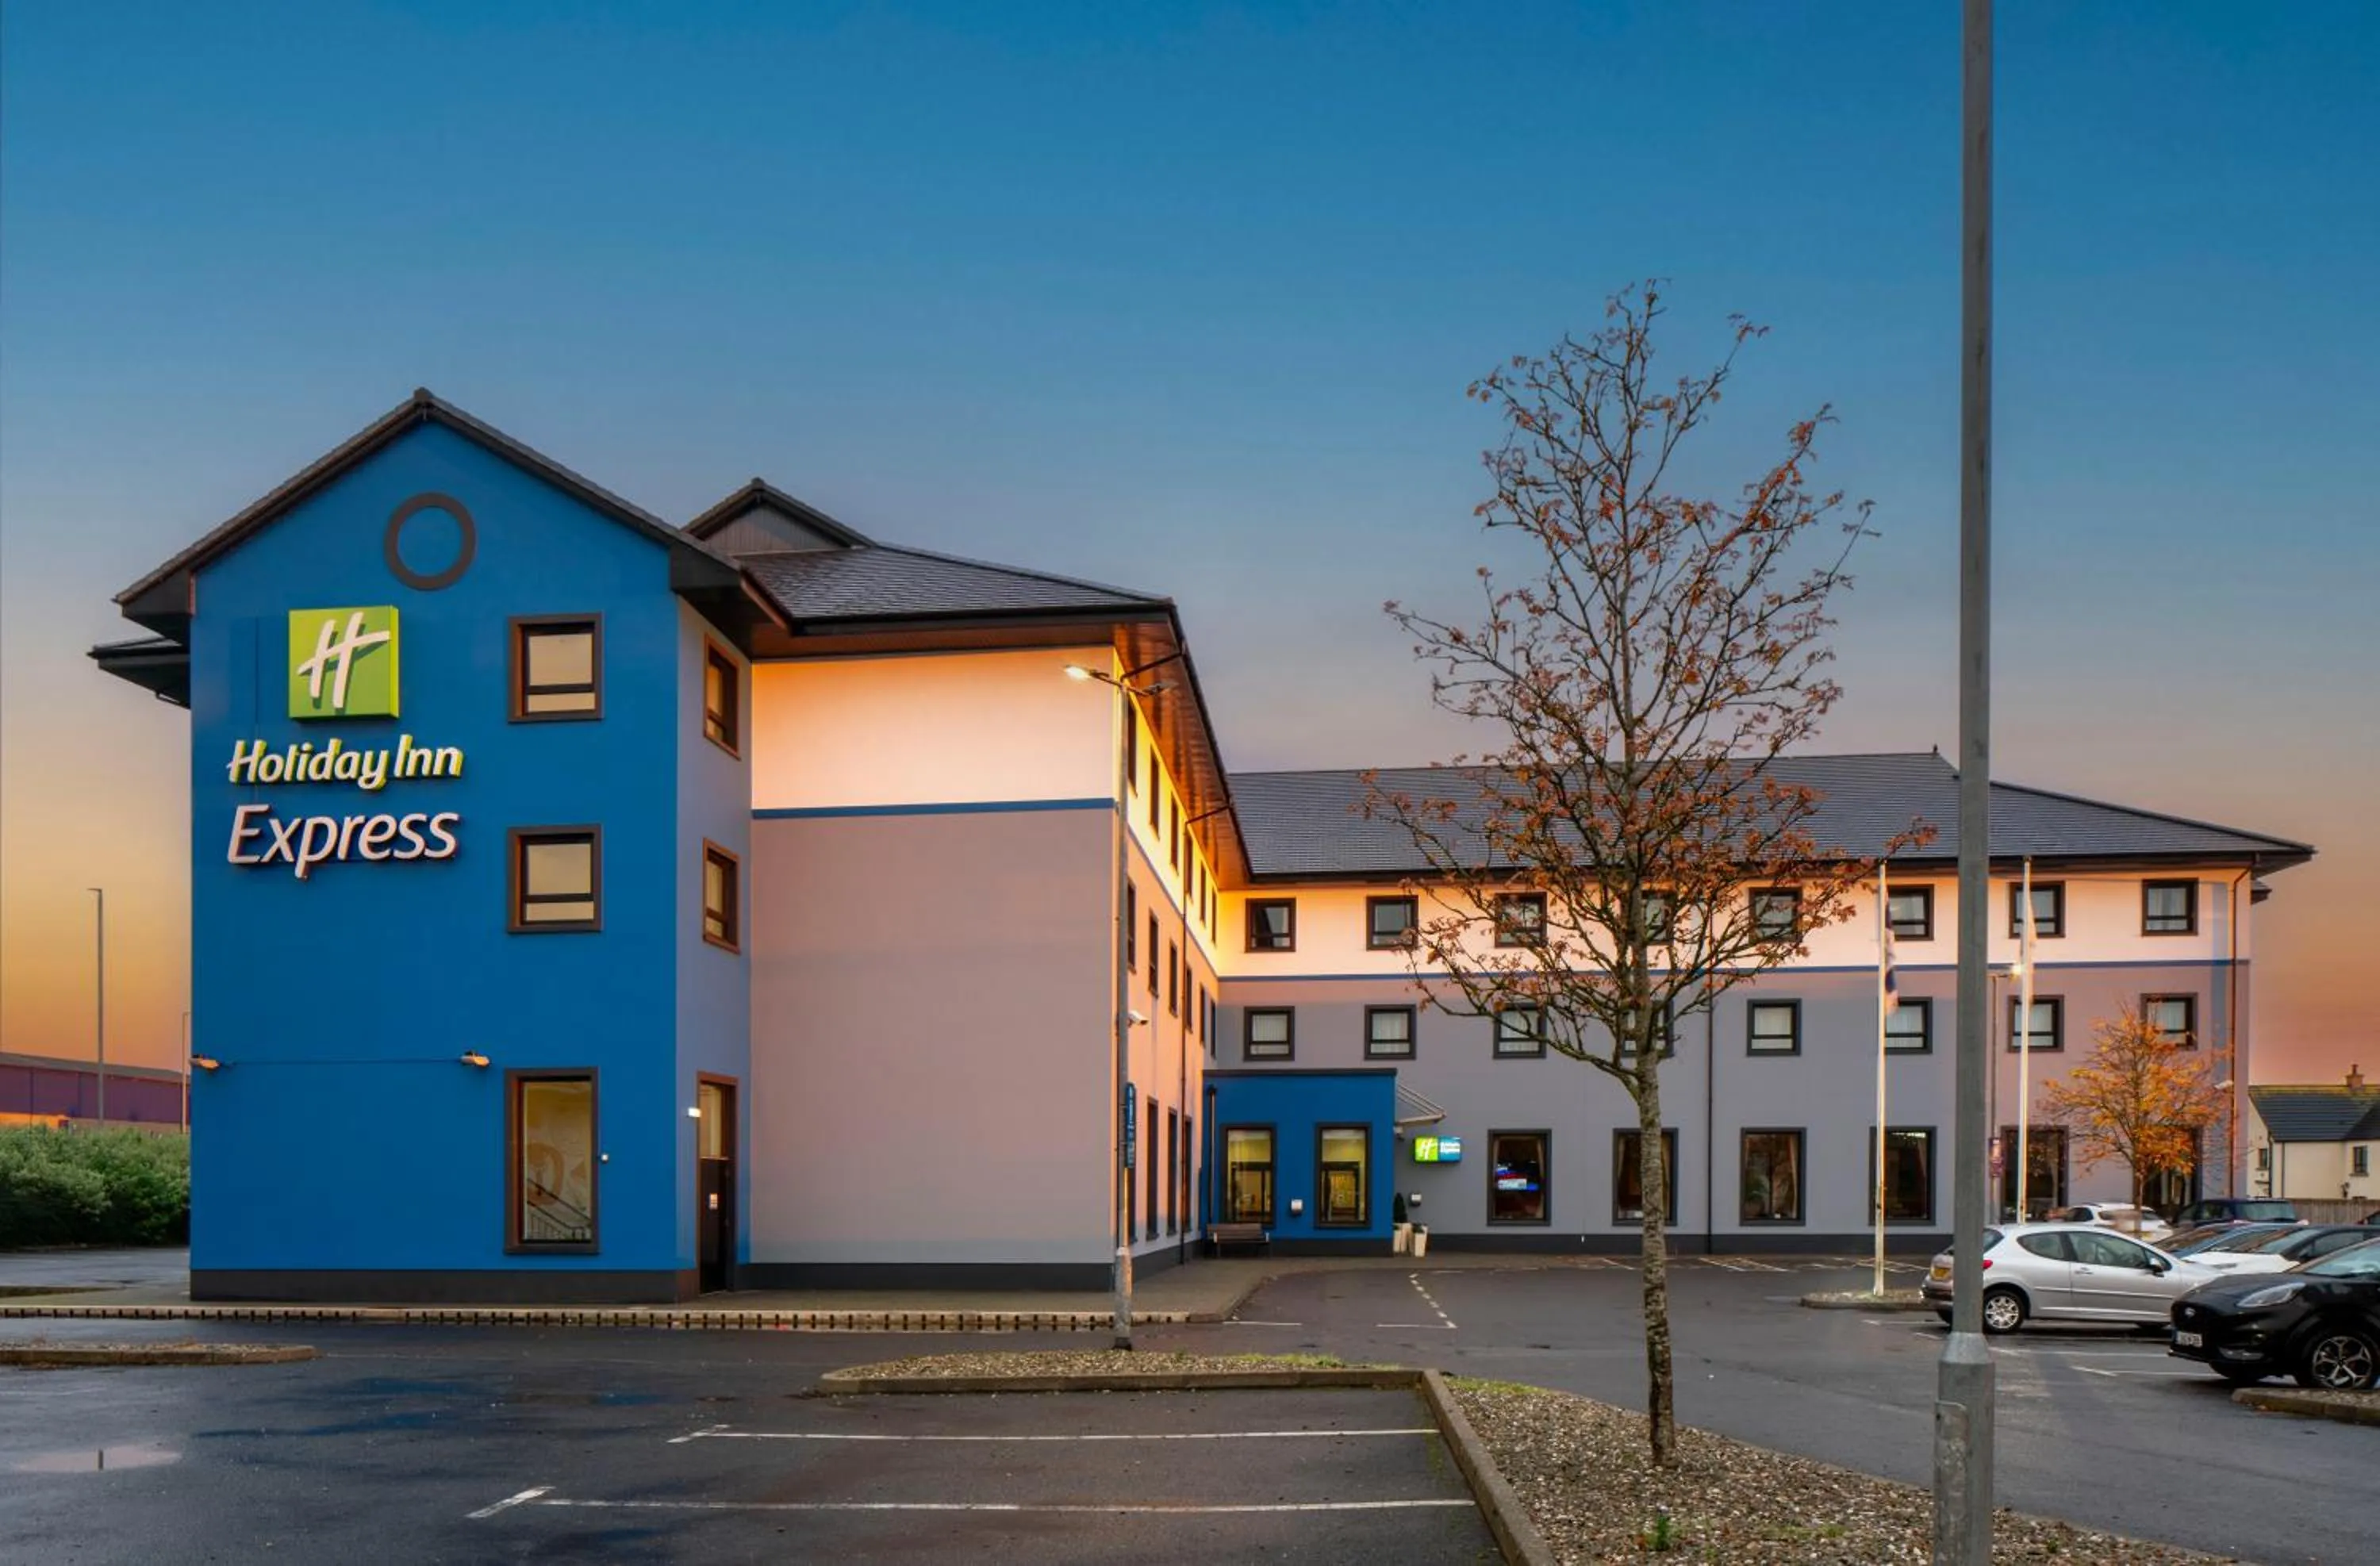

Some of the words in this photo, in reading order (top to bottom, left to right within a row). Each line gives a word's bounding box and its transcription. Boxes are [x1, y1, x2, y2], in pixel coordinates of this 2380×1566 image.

[297, 612, 390, 708] H
[227, 738, 389, 790] Holiday
[394, 734, 463, 777] Inn
[228, 804, 460, 880] Express
